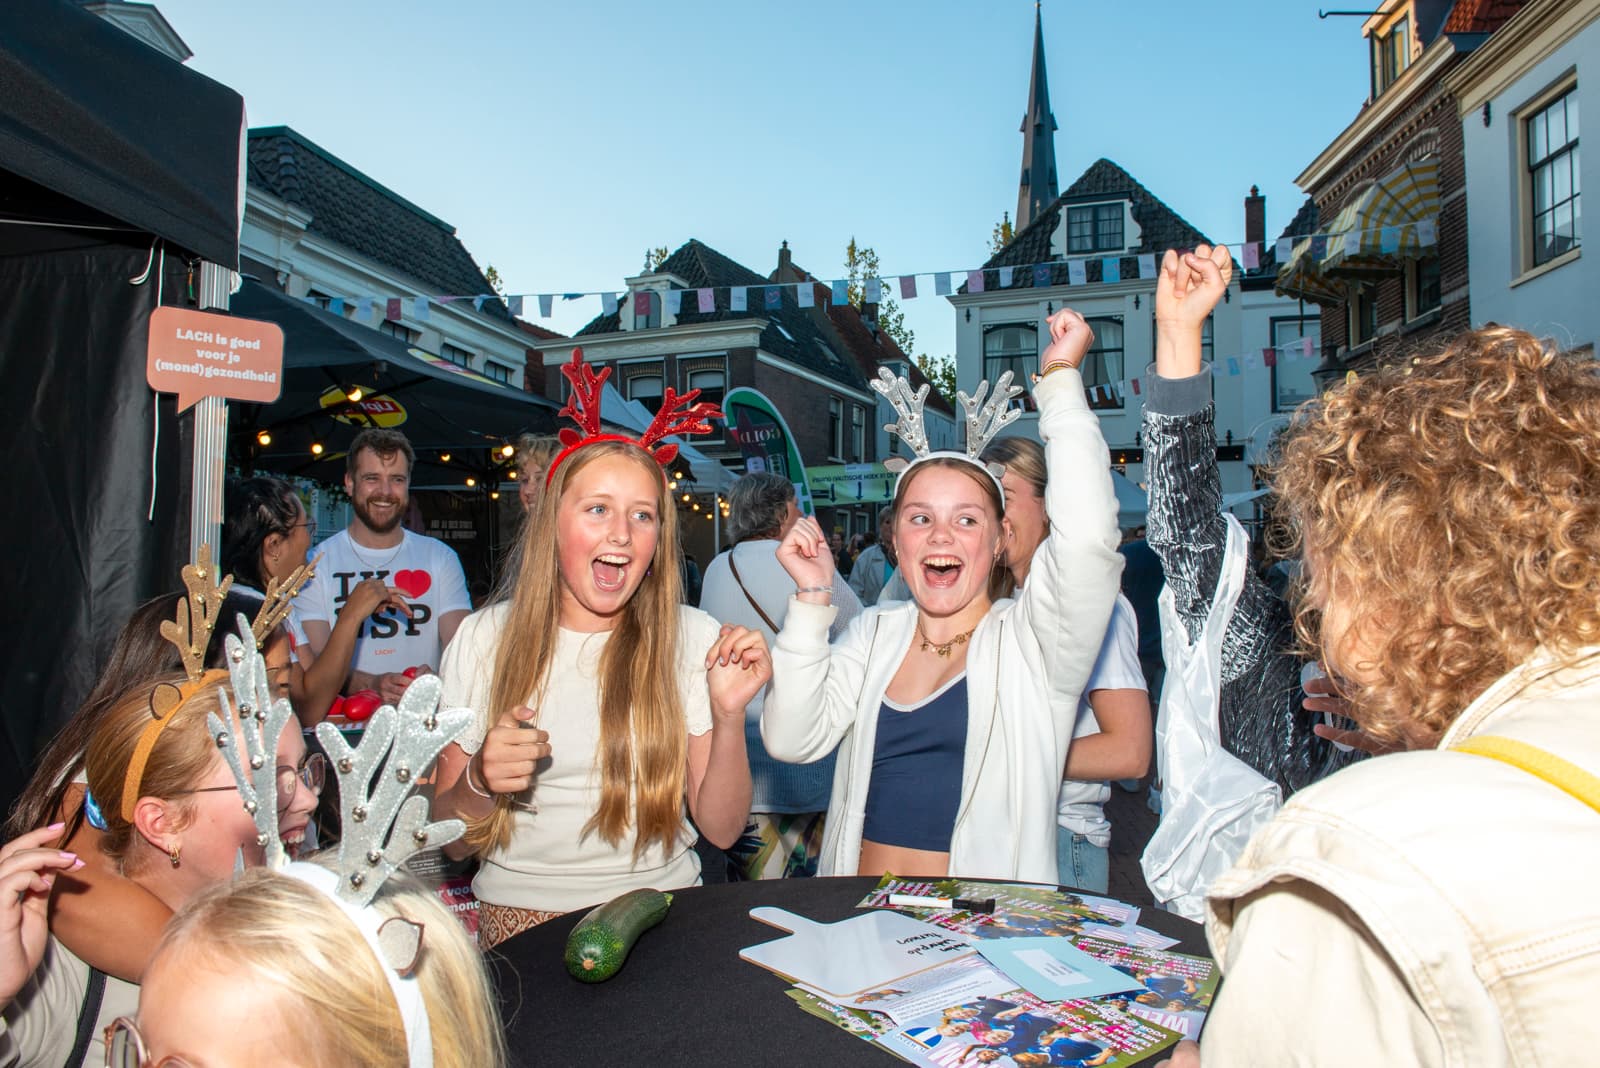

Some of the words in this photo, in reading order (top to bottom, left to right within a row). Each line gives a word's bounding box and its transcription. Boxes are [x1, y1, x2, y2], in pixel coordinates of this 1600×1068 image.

[176, 328, 213, 343] LACH
[215, 333, 227, 345] is
[230, 337, 261, 350] goed
[196, 349, 226, 360] voor
[228, 352, 240, 364] je
[155, 359, 276, 383] (mond)gezondheid
[447, 886, 474, 897] voo
